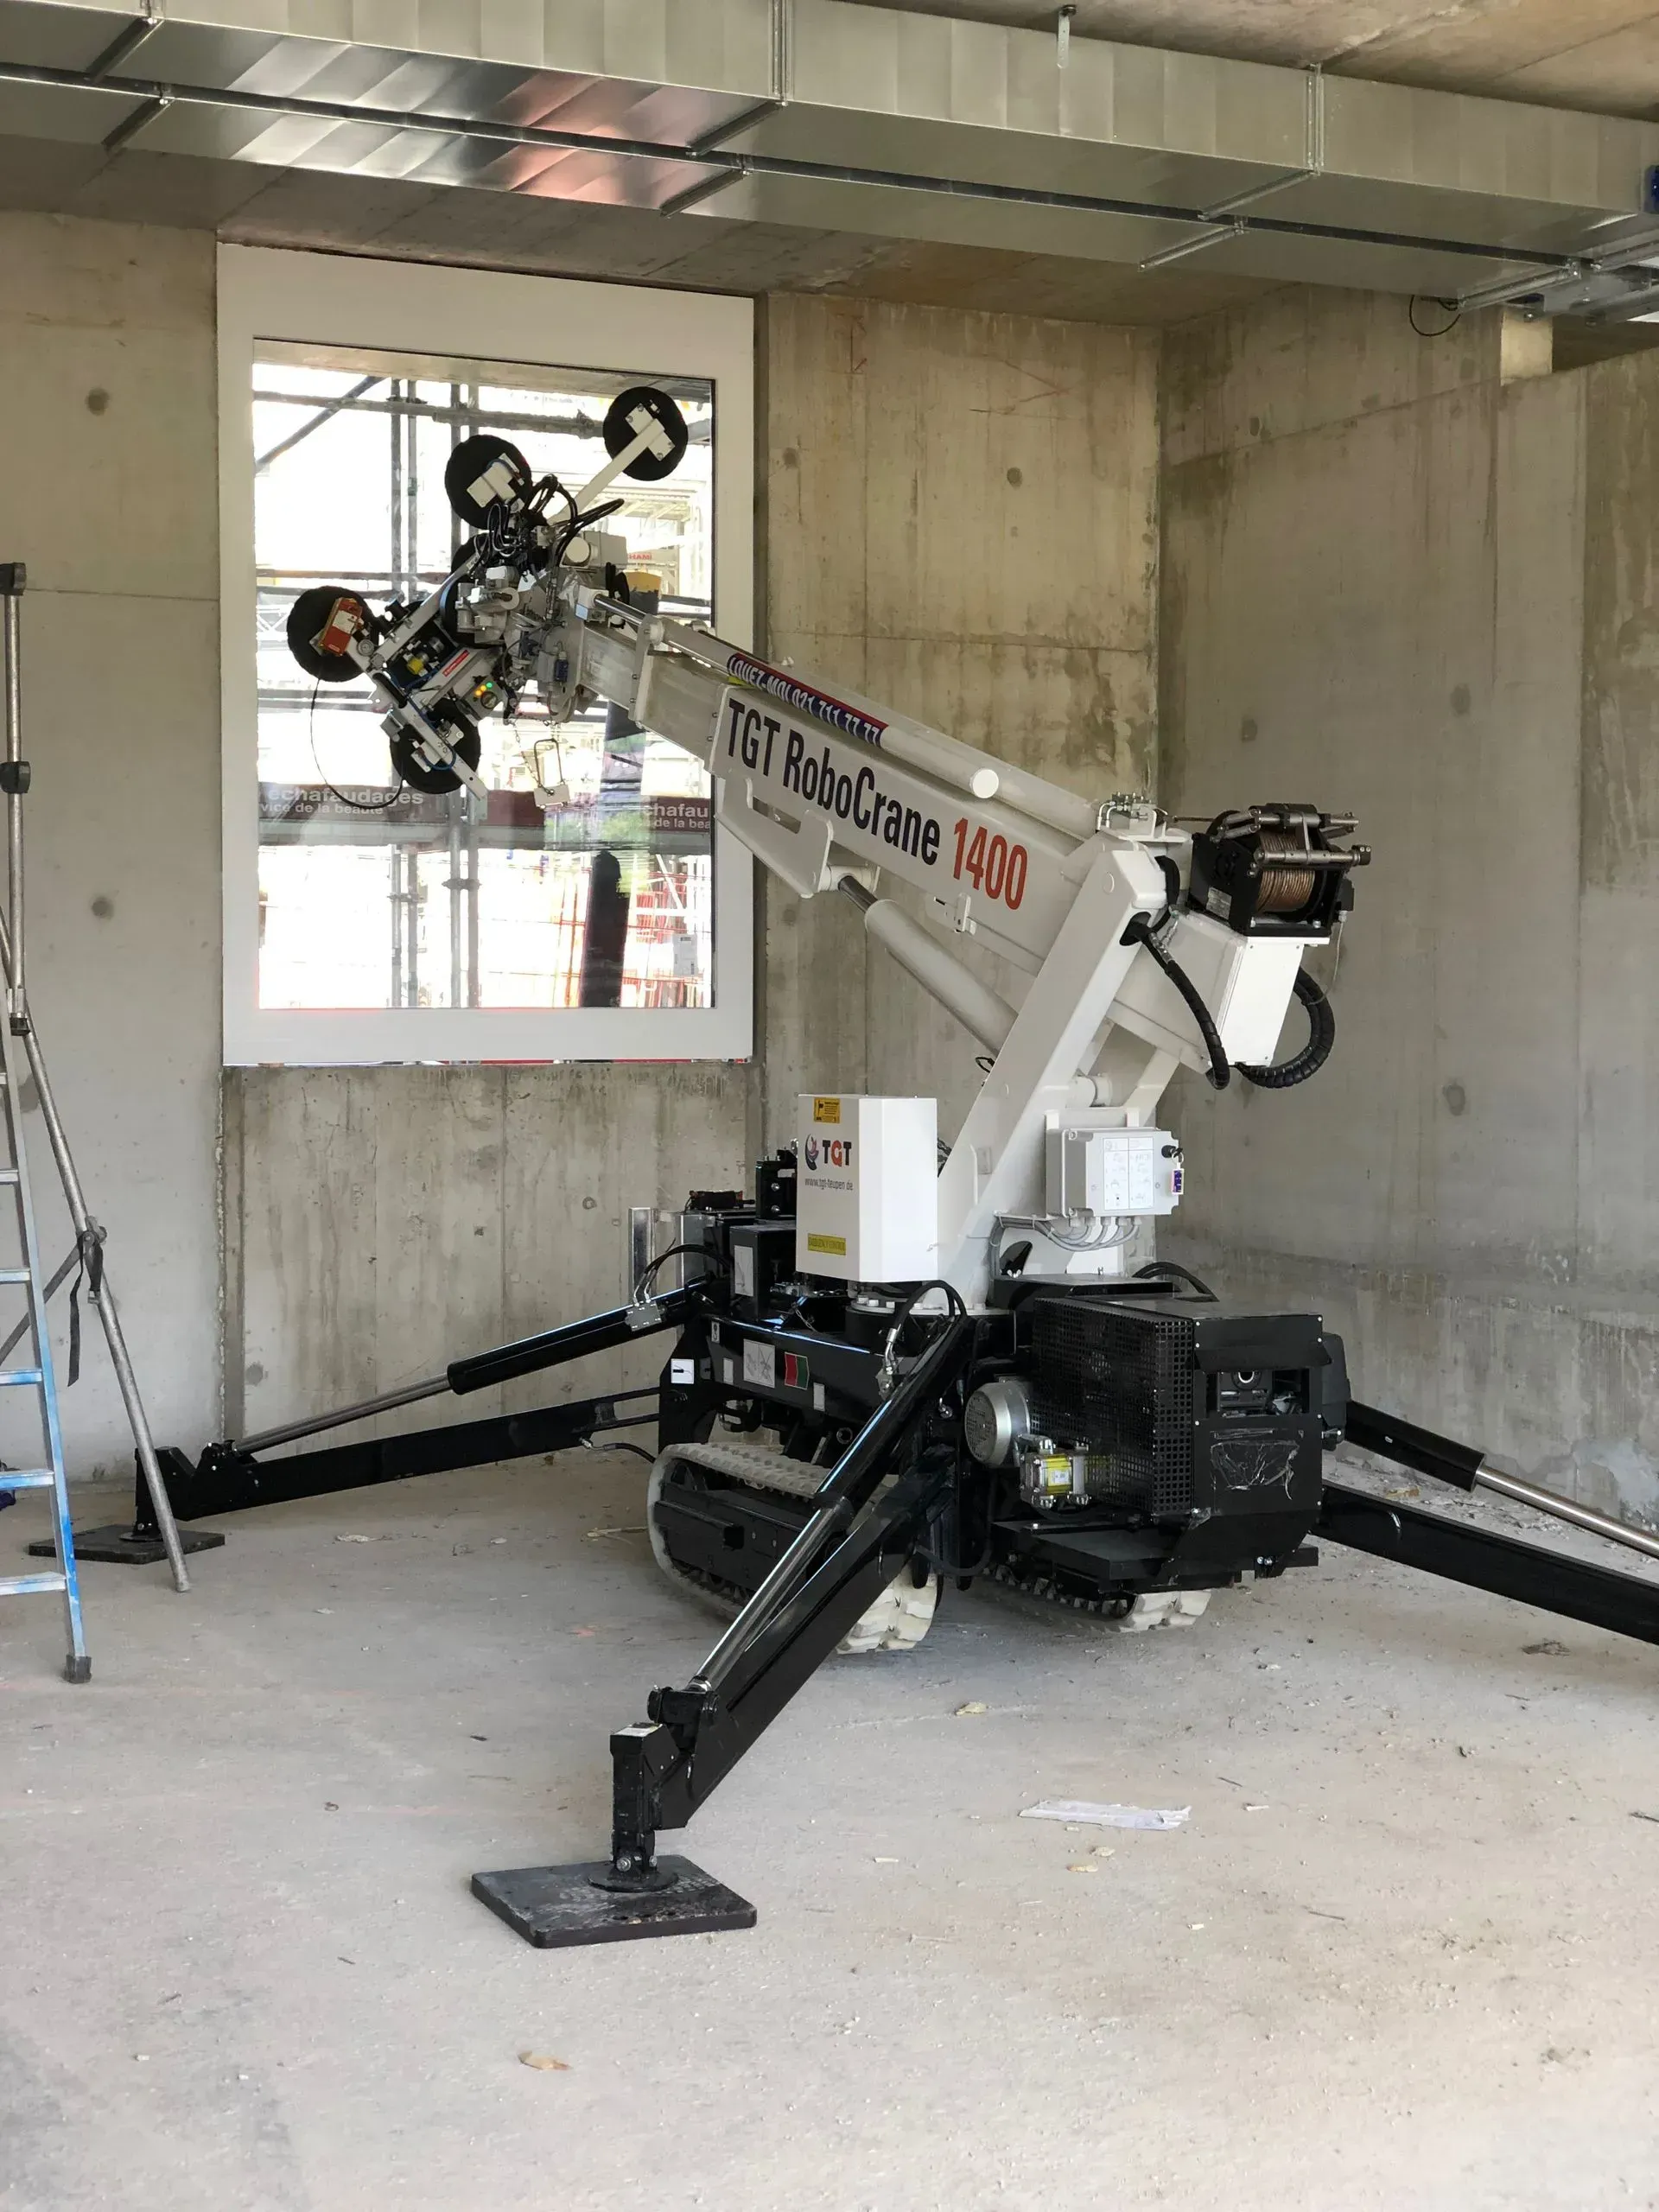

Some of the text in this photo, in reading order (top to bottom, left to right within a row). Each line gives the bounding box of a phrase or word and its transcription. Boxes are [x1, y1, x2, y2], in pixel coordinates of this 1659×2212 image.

[728, 657, 881, 748] LOUEZ-MOI 021 711 77 77
[295, 802, 315, 813] de
[319, 802, 330, 813] la
[728, 698, 1027, 911] TGT RoboCrane 1400
[654, 817, 670, 828] de
[674, 818, 685, 828] la
[823, 1140, 852, 1166] TGT
